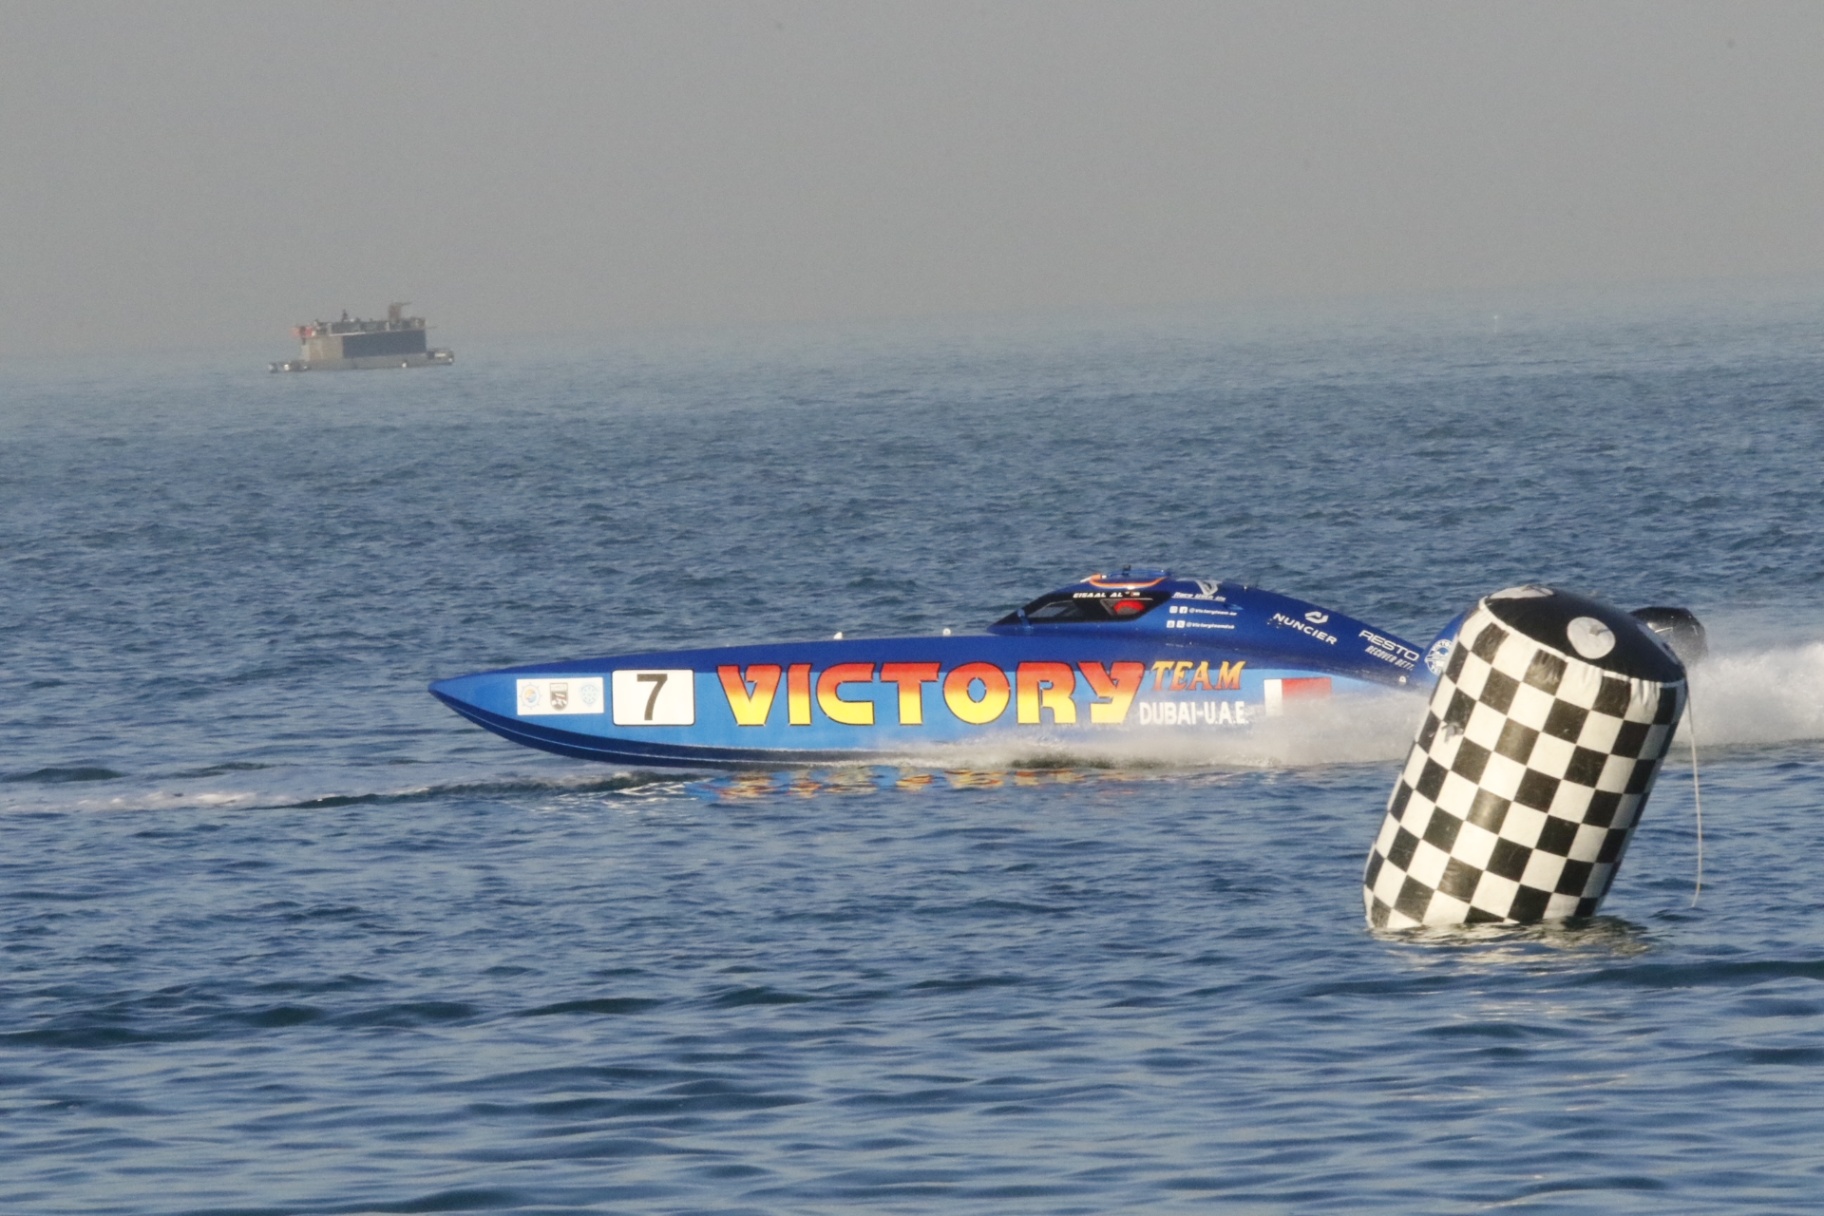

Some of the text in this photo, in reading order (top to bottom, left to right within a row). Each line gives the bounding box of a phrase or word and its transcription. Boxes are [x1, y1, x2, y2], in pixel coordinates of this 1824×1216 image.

[1273, 612, 1338, 645] NUNCIER
[717, 662, 1145, 725] VICTORY
[1150, 660, 1246, 692] TEAM
[637, 673, 668, 721] 7
